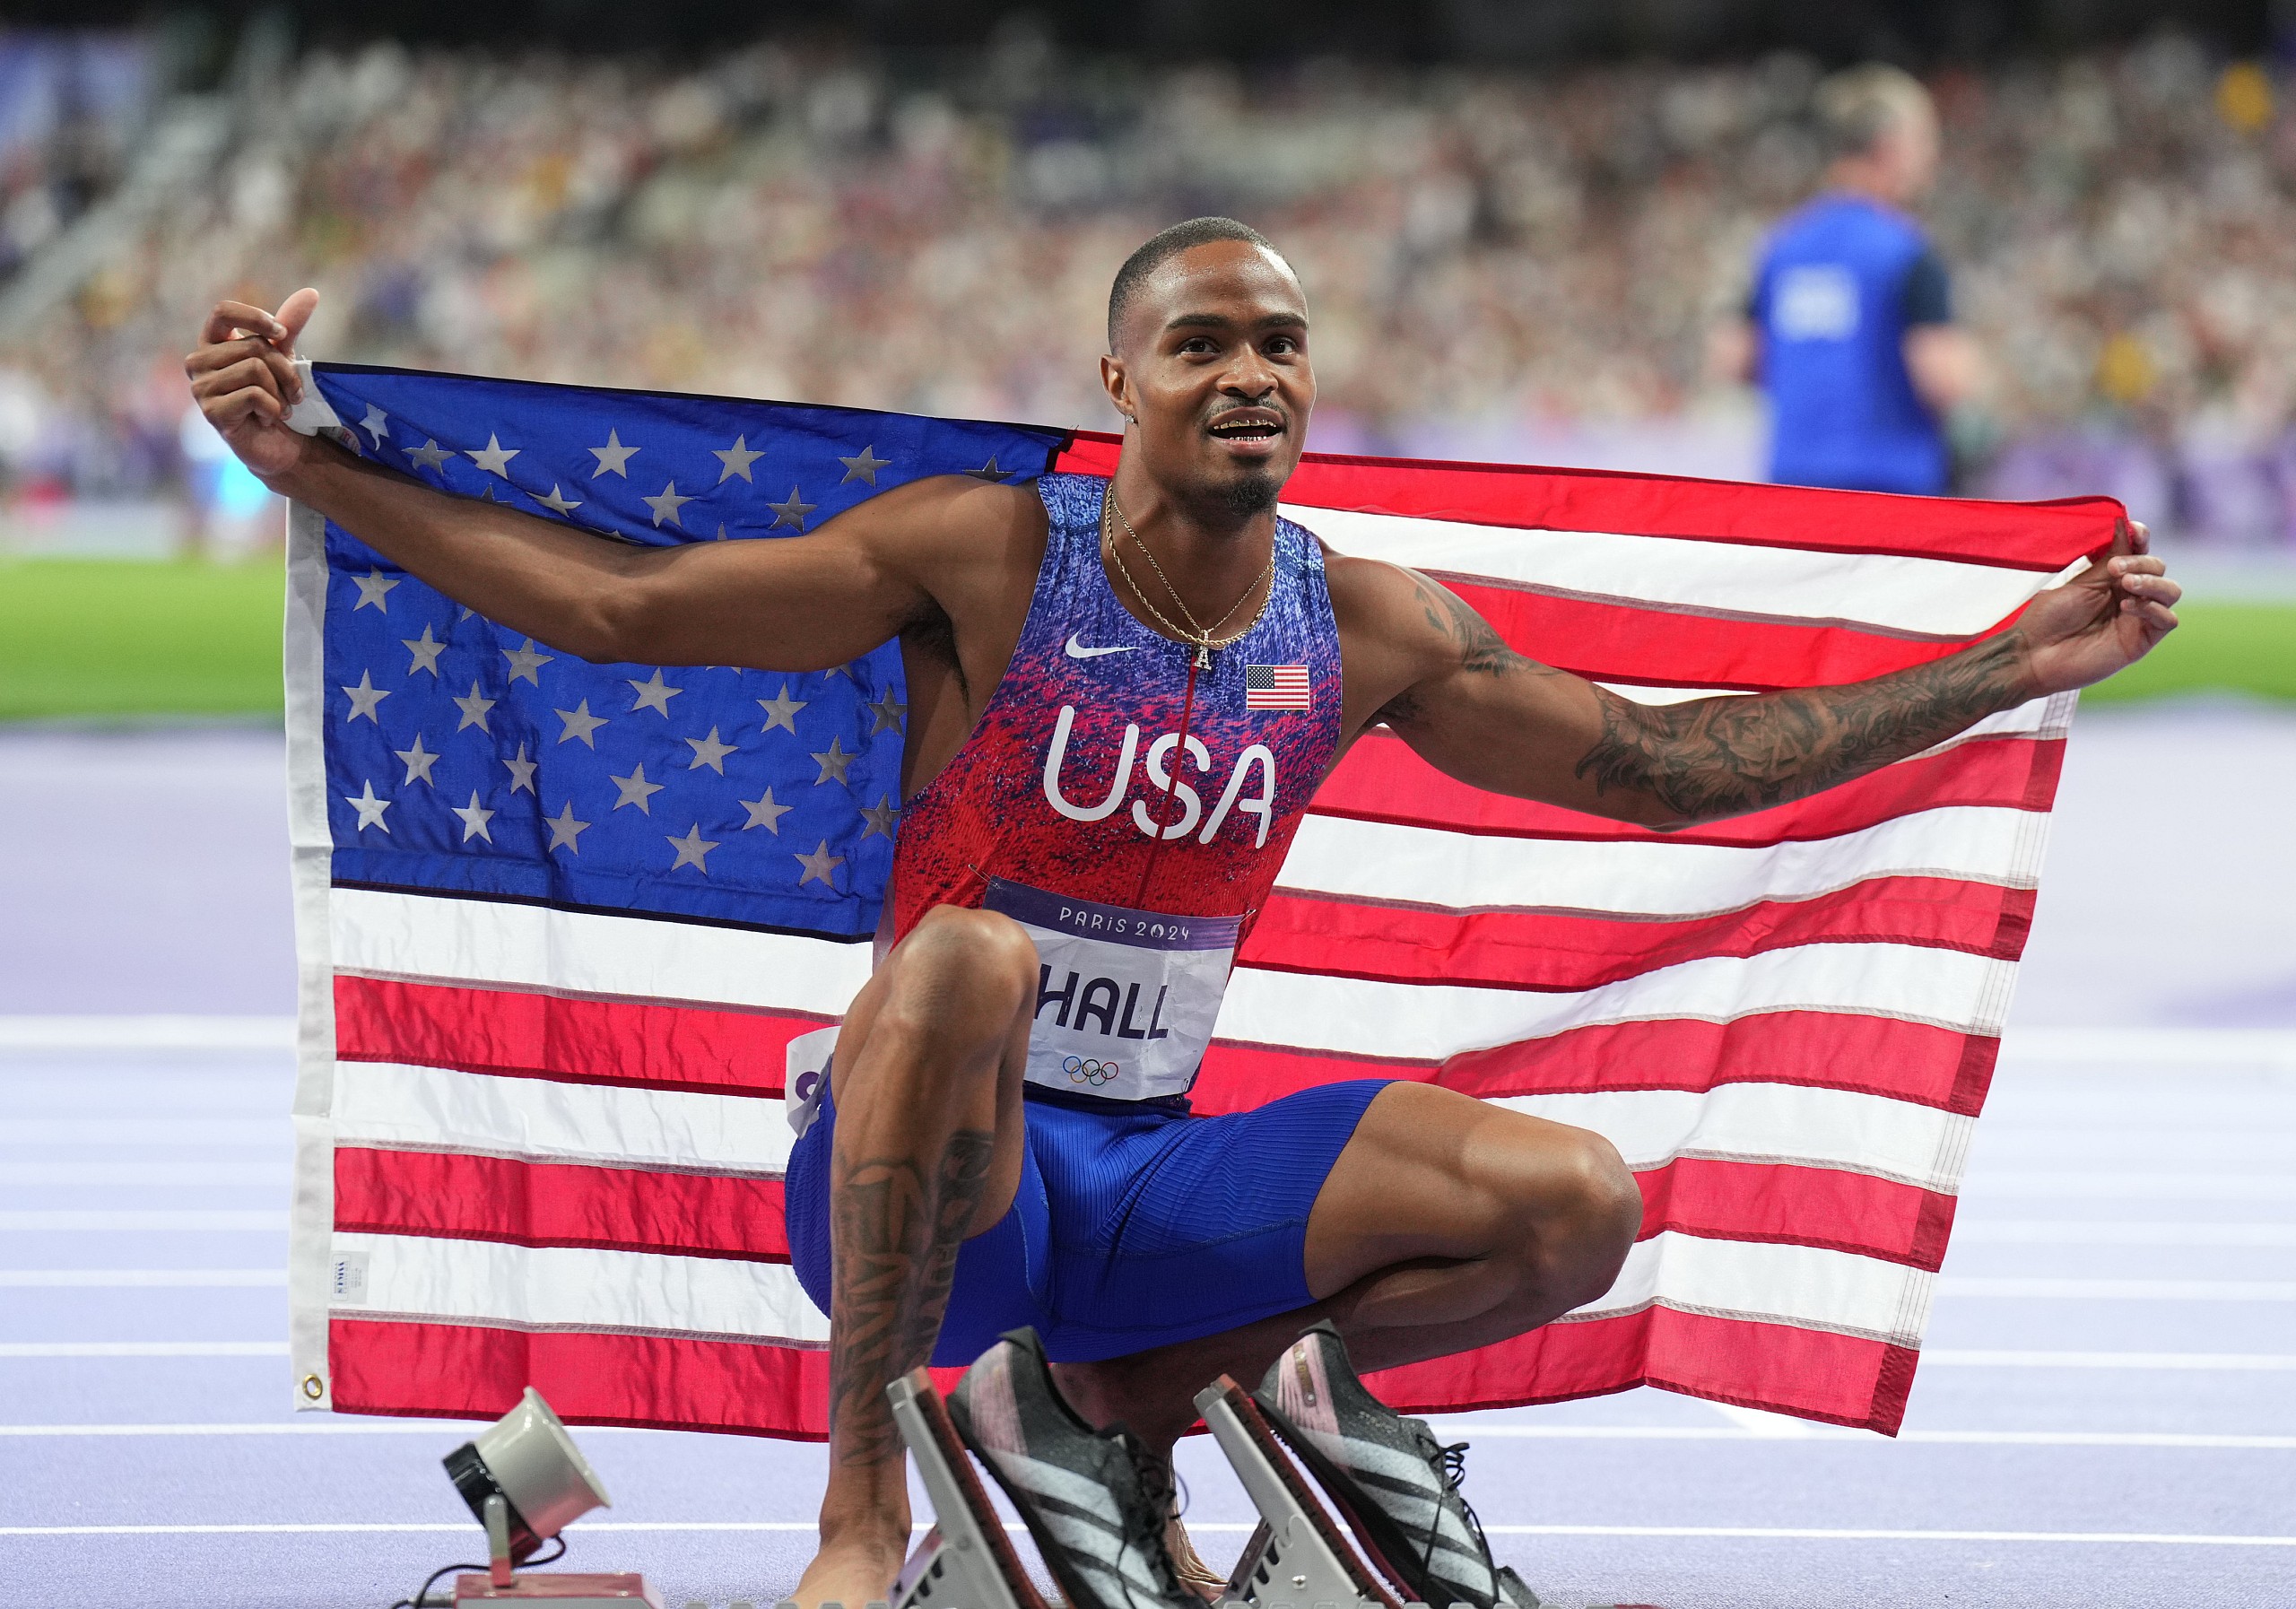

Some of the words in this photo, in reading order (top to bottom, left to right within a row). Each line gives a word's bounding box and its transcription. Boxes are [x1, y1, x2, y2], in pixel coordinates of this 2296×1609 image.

[1043, 705, 1275, 849] USA
[1135, 921, 1189, 941] 2024
[1033, 963, 1169, 1040] HALL
